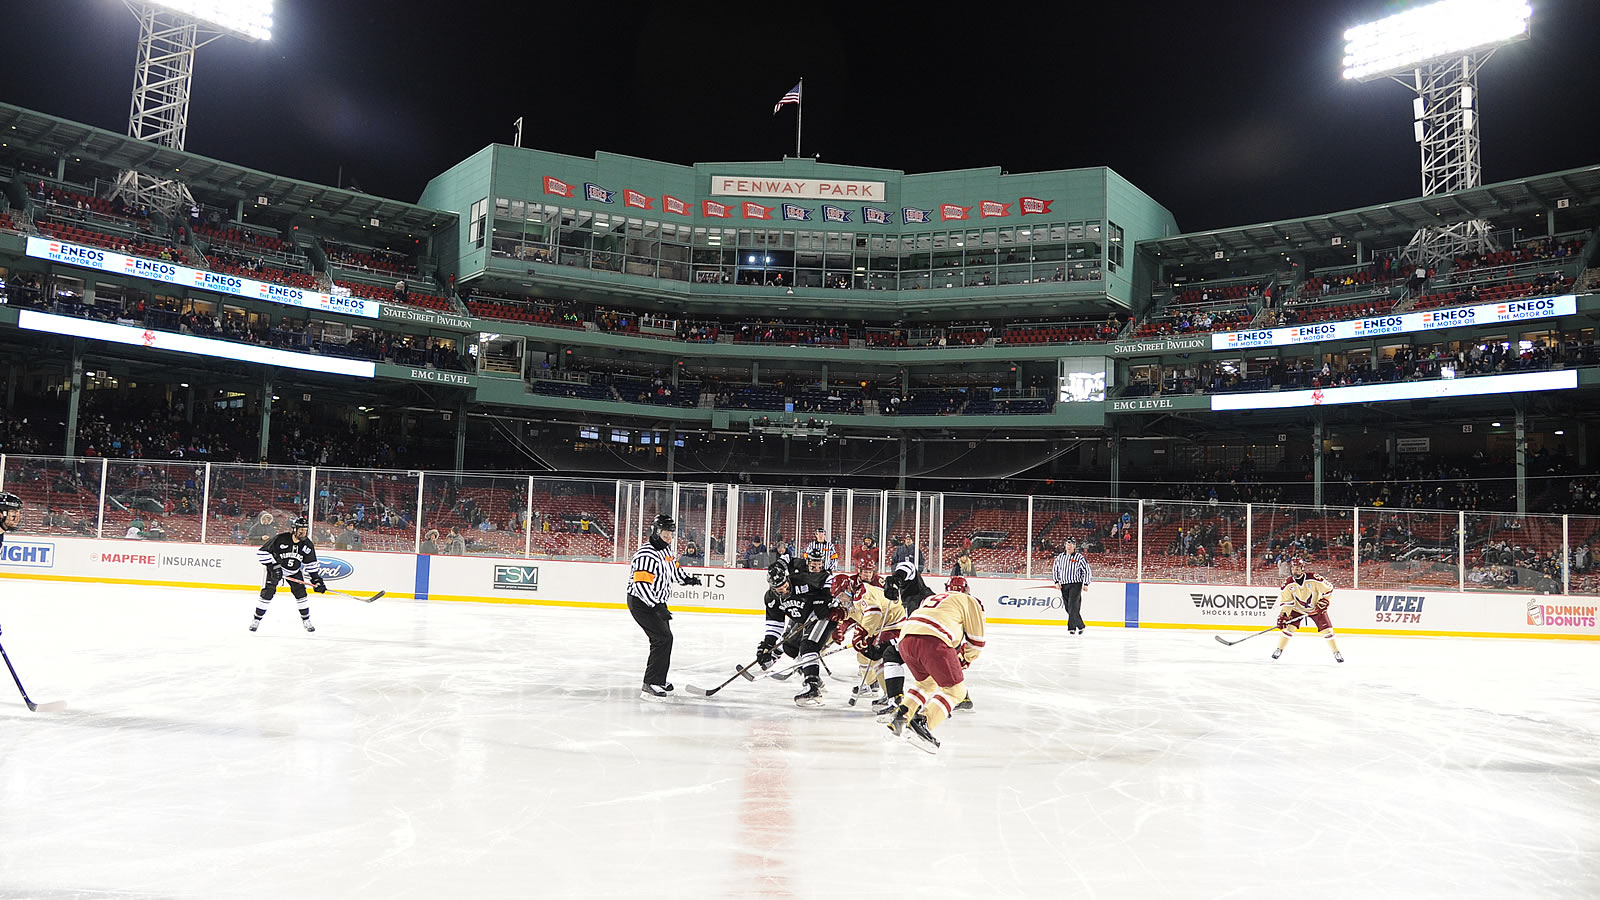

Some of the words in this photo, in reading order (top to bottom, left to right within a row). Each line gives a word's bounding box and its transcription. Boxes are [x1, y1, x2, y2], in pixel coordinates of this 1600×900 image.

[723, 180, 806, 194] FENWAY
[819, 183, 873, 197] PARK
[60, 245, 104, 262] ENEOS
[48, 252, 61, 260] THE
[63, 255, 90, 266] MOTOR
[92, 260, 103, 268] OIL
[135, 260, 176, 275] ENEOS
[124, 267, 136, 275] THE
[138, 270, 162, 280] MOTOR
[164, 274, 175, 282] OIL
[205, 273, 242, 288] ENEOS
[194, 280, 206, 288] THE
[207, 283, 230, 292] MOTOR
[268, 286, 303, 300] ENEOS
[271, 294, 292, 303] MOTOR
[329, 296, 365, 309] ENEOS
[1508, 299, 1554, 313] ENEOS
[332, 305, 353, 313] MOTOR
[1433, 308, 1475, 321] ENEOS
[1512, 311, 1540, 319] MOTOR
[1542, 308, 1555, 316] OIL
[383, 307, 407, 319] STATE
[407, 311, 436, 323] STREET
[437, 315, 472, 329] PAVILION
[1363, 317, 1402, 329] ENEOS
[1437, 319, 1462, 328] MOTOR
[1299, 324, 1336, 336] ENEOS
[1368, 327, 1390, 335] MOTOR
[1237, 331, 1273, 342] ENEOS
[1114, 345, 1137, 354] STATE
[1137, 342, 1164, 352] STREET
[1167, 339, 1205, 350] PAVILION
[411, 369, 435, 380] EMC
[437, 373, 470, 385] LEVEL
[1113, 401, 1137, 410] EMC
[1139, 399, 1173, 409] LEVEL
[101, 553, 156, 565] MAPFRE
[162, 556, 222, 568] INSURANCE
[287, 559, 295, 567] 5
[495, 566, 538, 583] FSM
[702, 591, 725, 600] Plan
[795, 586, 801, 595] A
[1201, 594, 1267, 610] MONROE
[1375, 595, 1425, 613] WEEI
[787, 608, 802, 618] 26
[1546, 605, 1598, 617] DUNKIN'
[1375, 612, 1422, 624] 93.7FM
[1546, 616, 1595, 627] DONUTS
